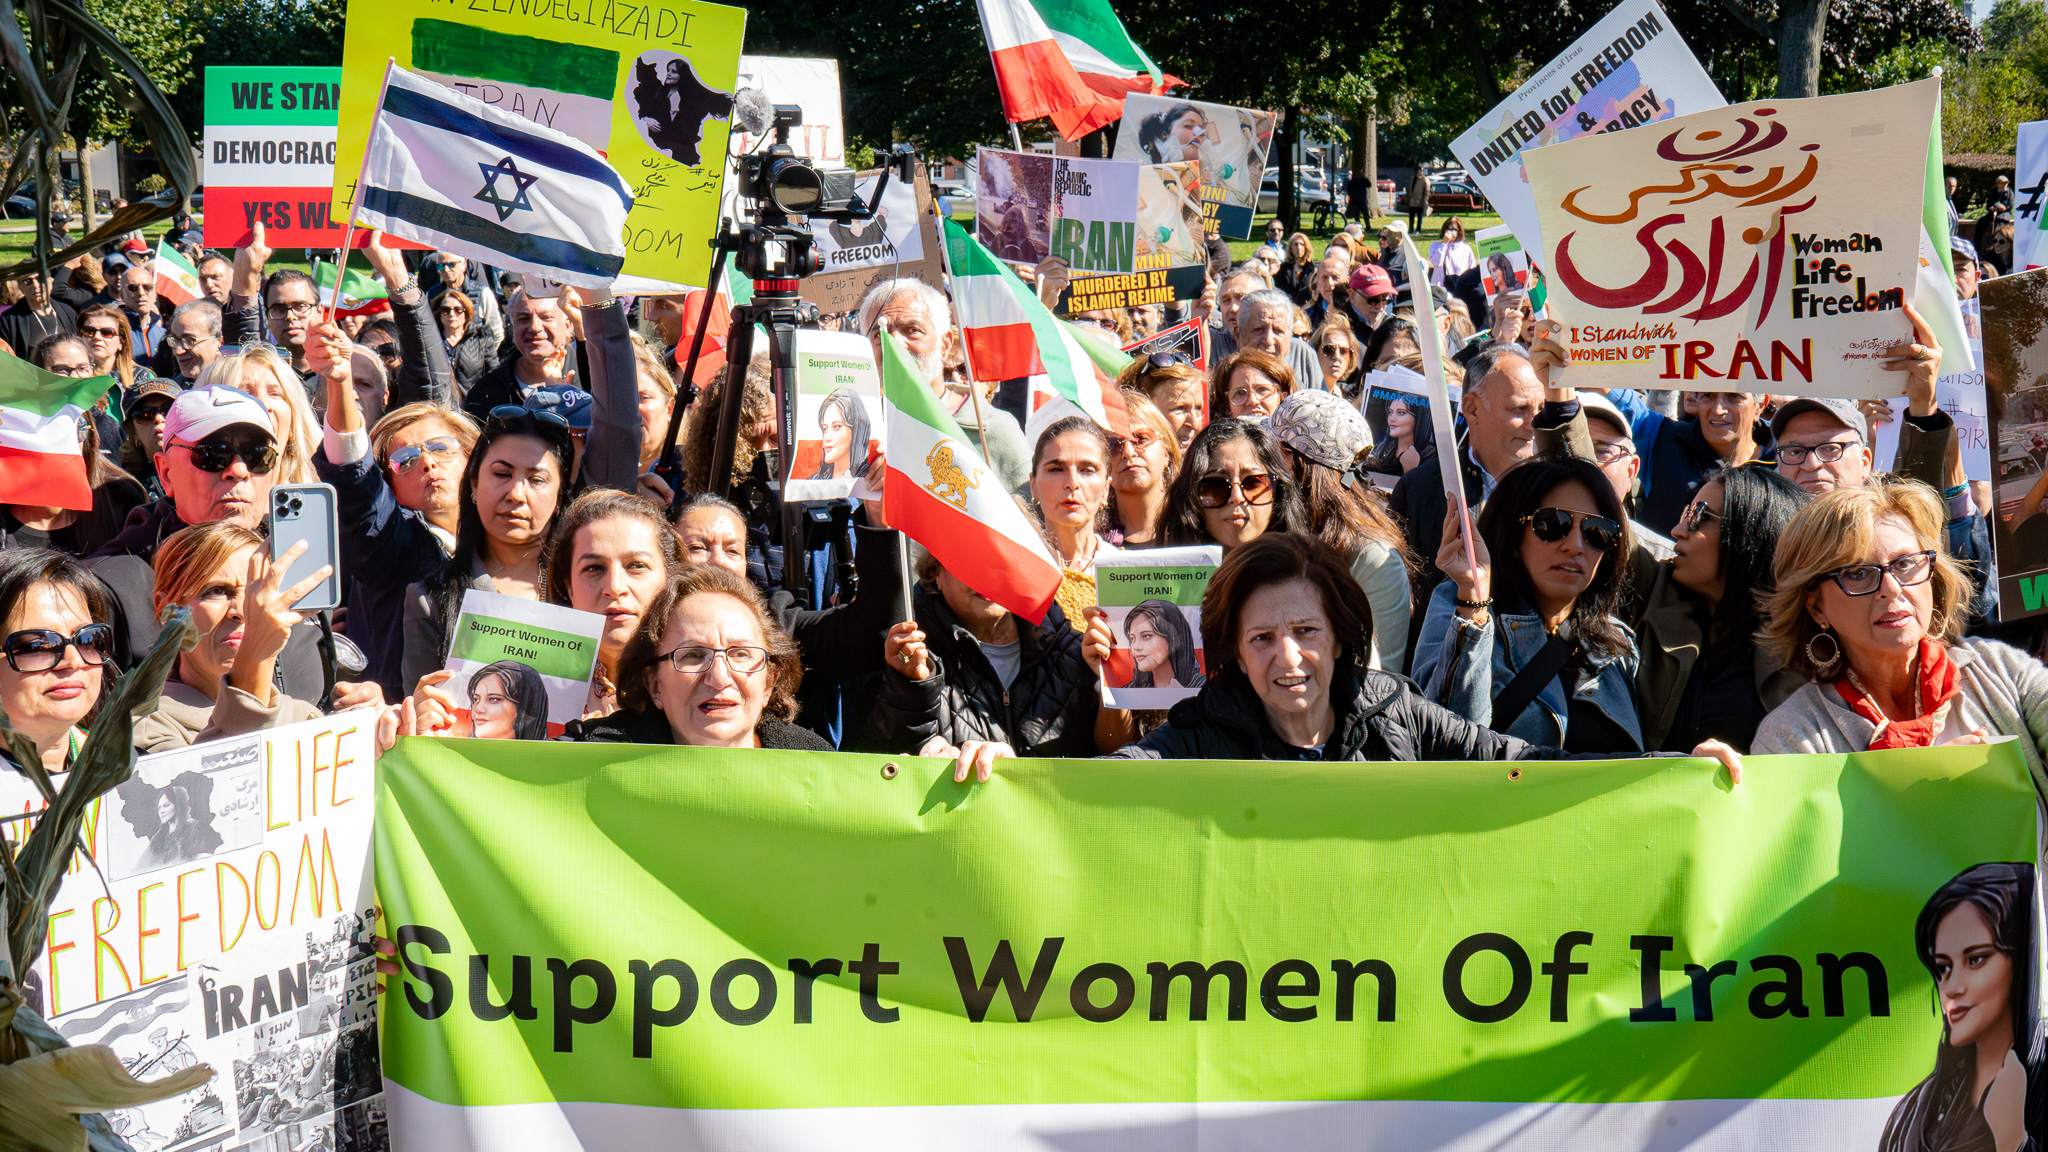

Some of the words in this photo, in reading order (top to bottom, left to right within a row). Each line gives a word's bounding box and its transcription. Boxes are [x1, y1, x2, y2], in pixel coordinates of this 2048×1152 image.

[1517, 68, 1557, 102] Provinces
[1565, 45, 1584, 65] Iran
[231, 82, 273, 110] WE
[280, 81, 341, 111] STAN
[1469, 109, 1546, 177] UNITED
[1540, 84, 1577, 122] for
[1570, 10, 1664, 97] FREEDOM
[1576, 111, 1598, 132] &
[1657, 108, 1789, 163] زن
[213, 140, 337, 165] DEMOCRAC
[1055, 158, 1070, 171] THE
[1054, 181, 1092, 198] REPUBLIC
[1055, 170, 1088, 185] ISLAMIC
[1560, 143, 1821, 225] زندگی
[242, 201, 291, 230] YES
[1053, 205, 1064, 218] VS
[1202, 202, 1220, 217] BY
[830, 244, 894, 265] FREEDOM
[1051, 217, 1135, 272] IRAN
[1790, 232, 1883, 257] Woman
[1134, 252, 1172, 271] MINI
[1555, 194, 1817, 332] آزادی
[1793, 257, 1853, 286] Life
[1072, 271, 1148, 296] MURDERED
[1149, 270, 1168, 287] BY
[1067, 294, 1126, 313] ISLAMIC
[1128, 285, 1176, 307] REJIME
[1791, 277, 1904, 319] Freedom
[1570, 327, 1580, 344] I
[808, 358, 840, 370] Support
[840, 360, 865, 371] Women
[1570, 346, 1628, 362] WOMEN
[1632, 345, 1656, 360] OF
[1659, 338, 1814, 383] IRAN
[835, 375, 856, 384] IRAN!
[1372, 388, 1430, 409] #MAHSAA
[1109, 572, 1151, 583] Support
[1152, 571, 1193, 581] Women
[1195, 570, 1208, 580] Of
[1143, 586, 1173, 596] IRAN!
[470, 620, 517, 639] Support
[518, 629, 566, 649] Women
[567, 640, 583, 652] Of
[503, 644, 538, 660] IRAN!
[266, 726, 358, 832] LIFE
[47, 828, 343, 1018] FREEDOM
[199, 961, 309, 1039] IRAN
[395, 924, 901, 1059] Support
[942, 935, 1398, 1025] Women
[1441, 931, 1594, 1025] Of
[1628, 933, 1891, 1024] Iran
